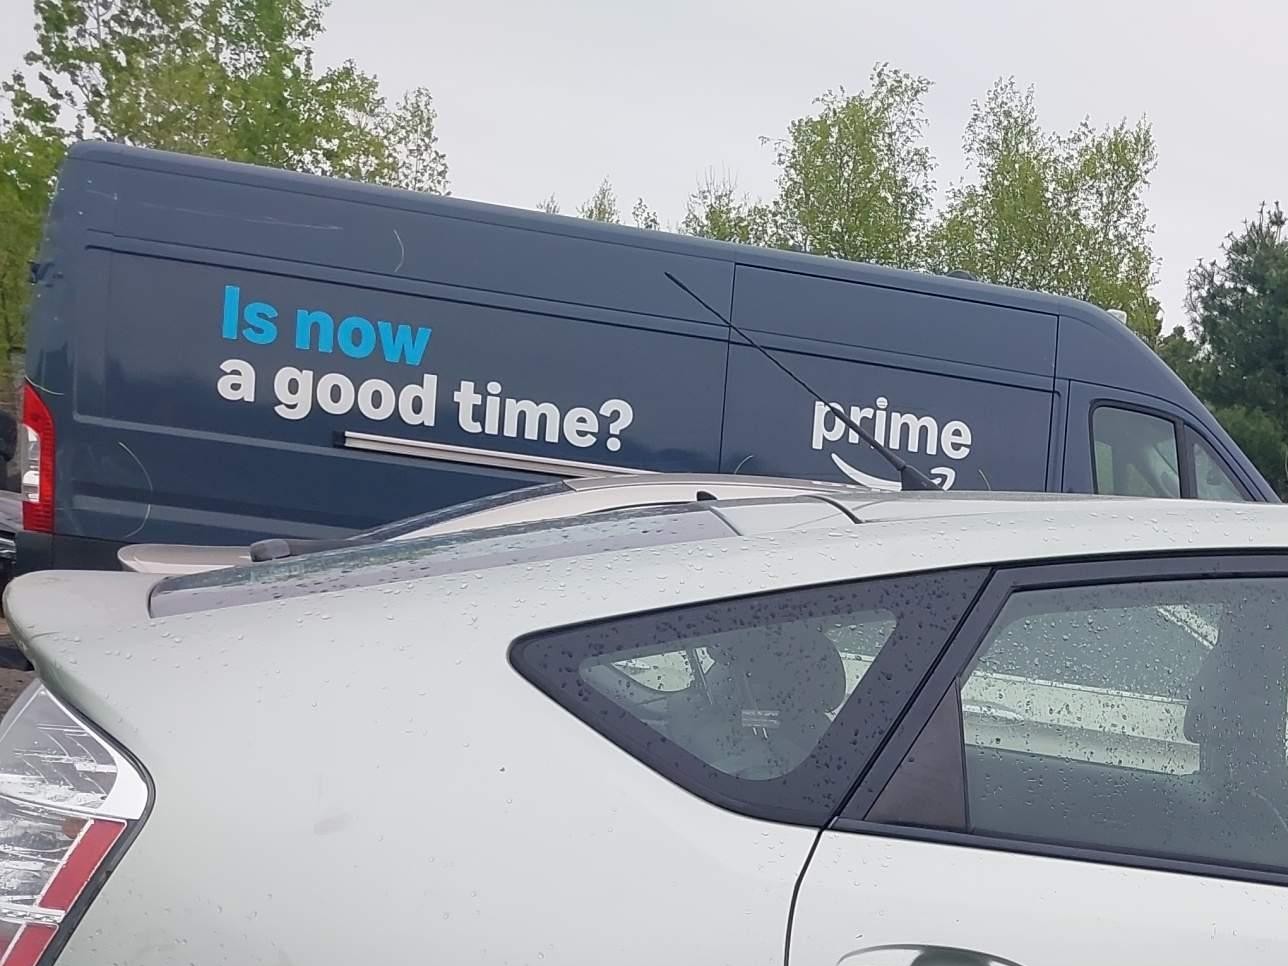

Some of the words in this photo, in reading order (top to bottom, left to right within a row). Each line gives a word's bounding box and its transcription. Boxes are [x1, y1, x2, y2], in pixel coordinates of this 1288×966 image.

[222, 284, 278, 345] Is
[295, 308, 432, 366] now
[216, 359, 257, 402] a
[273, 366, 438, 427] good
[453, 381, 634, 452] time?
[811, 396, 973, 460] prime
